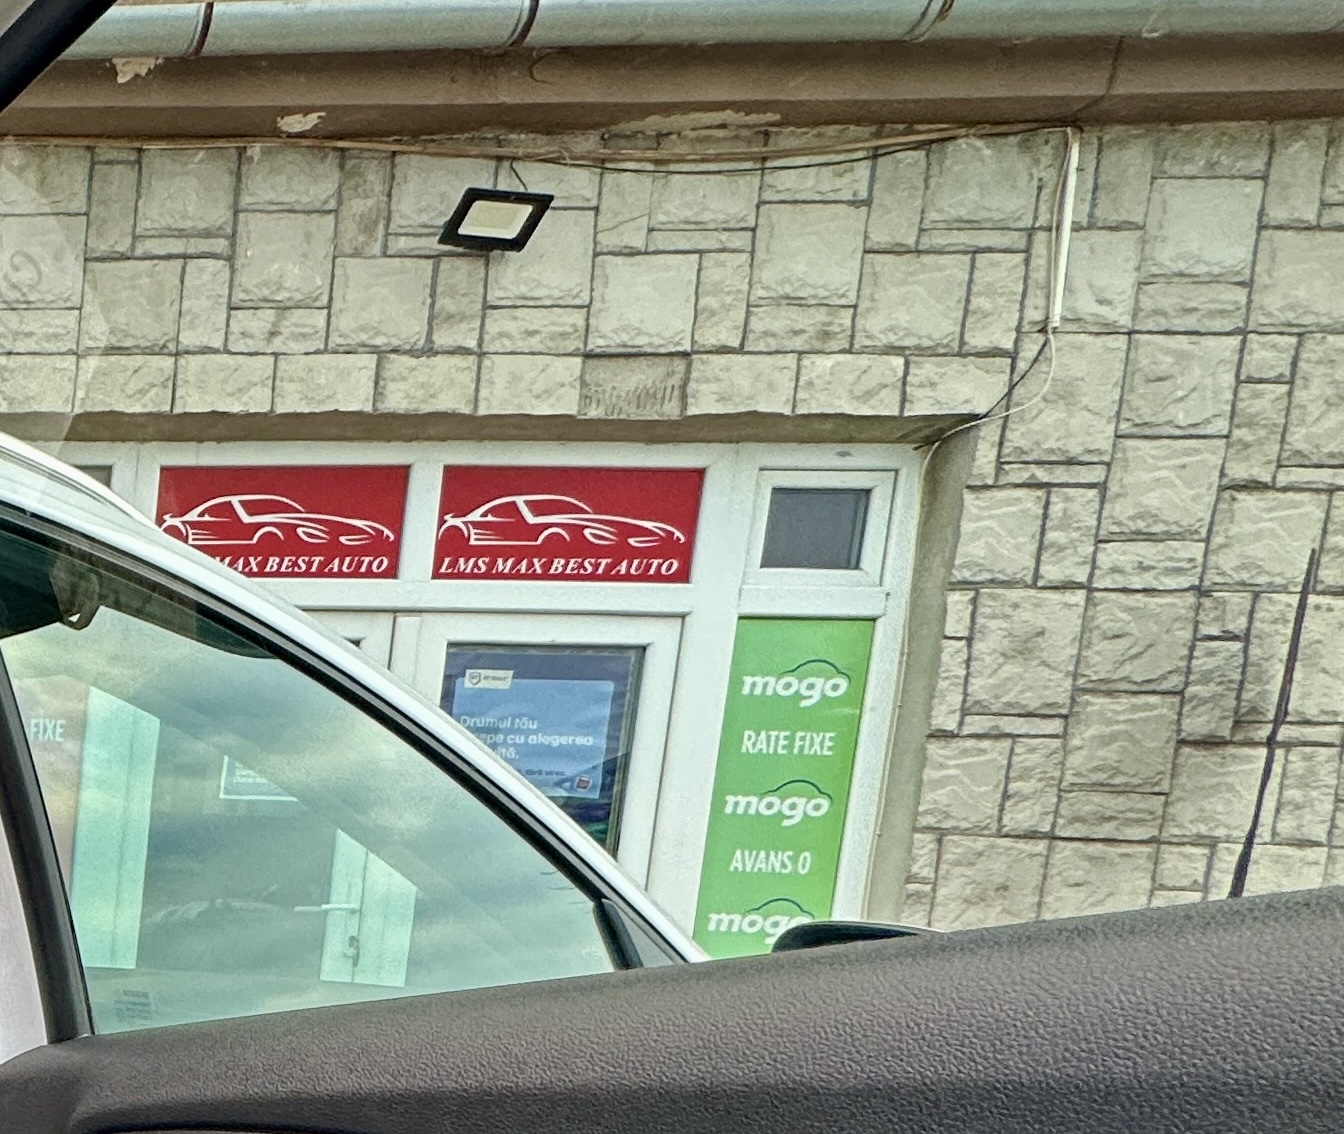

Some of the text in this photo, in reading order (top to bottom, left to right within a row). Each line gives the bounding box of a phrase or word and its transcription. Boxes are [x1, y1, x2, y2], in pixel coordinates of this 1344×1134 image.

[264, 556, 325, 573] BEST
[324, 556, 389, 573] AUTO
[439, 557, 679, 576] LMS MAX BEST AUTO
[742, 674, 848, 707] mogo
[29, 717, 66, 743] FIXE
[460, 715, 512, 729] Drumul
[506, 734, 525, 744] cu
[528, 733, 595, 747] alegerea
[741, 730, 836, 756] RATE FIXE
[723, 794, 831, 827] mogo
[729, 848, 794, 875] AVANS
[707, 912, 809, 944] mog
